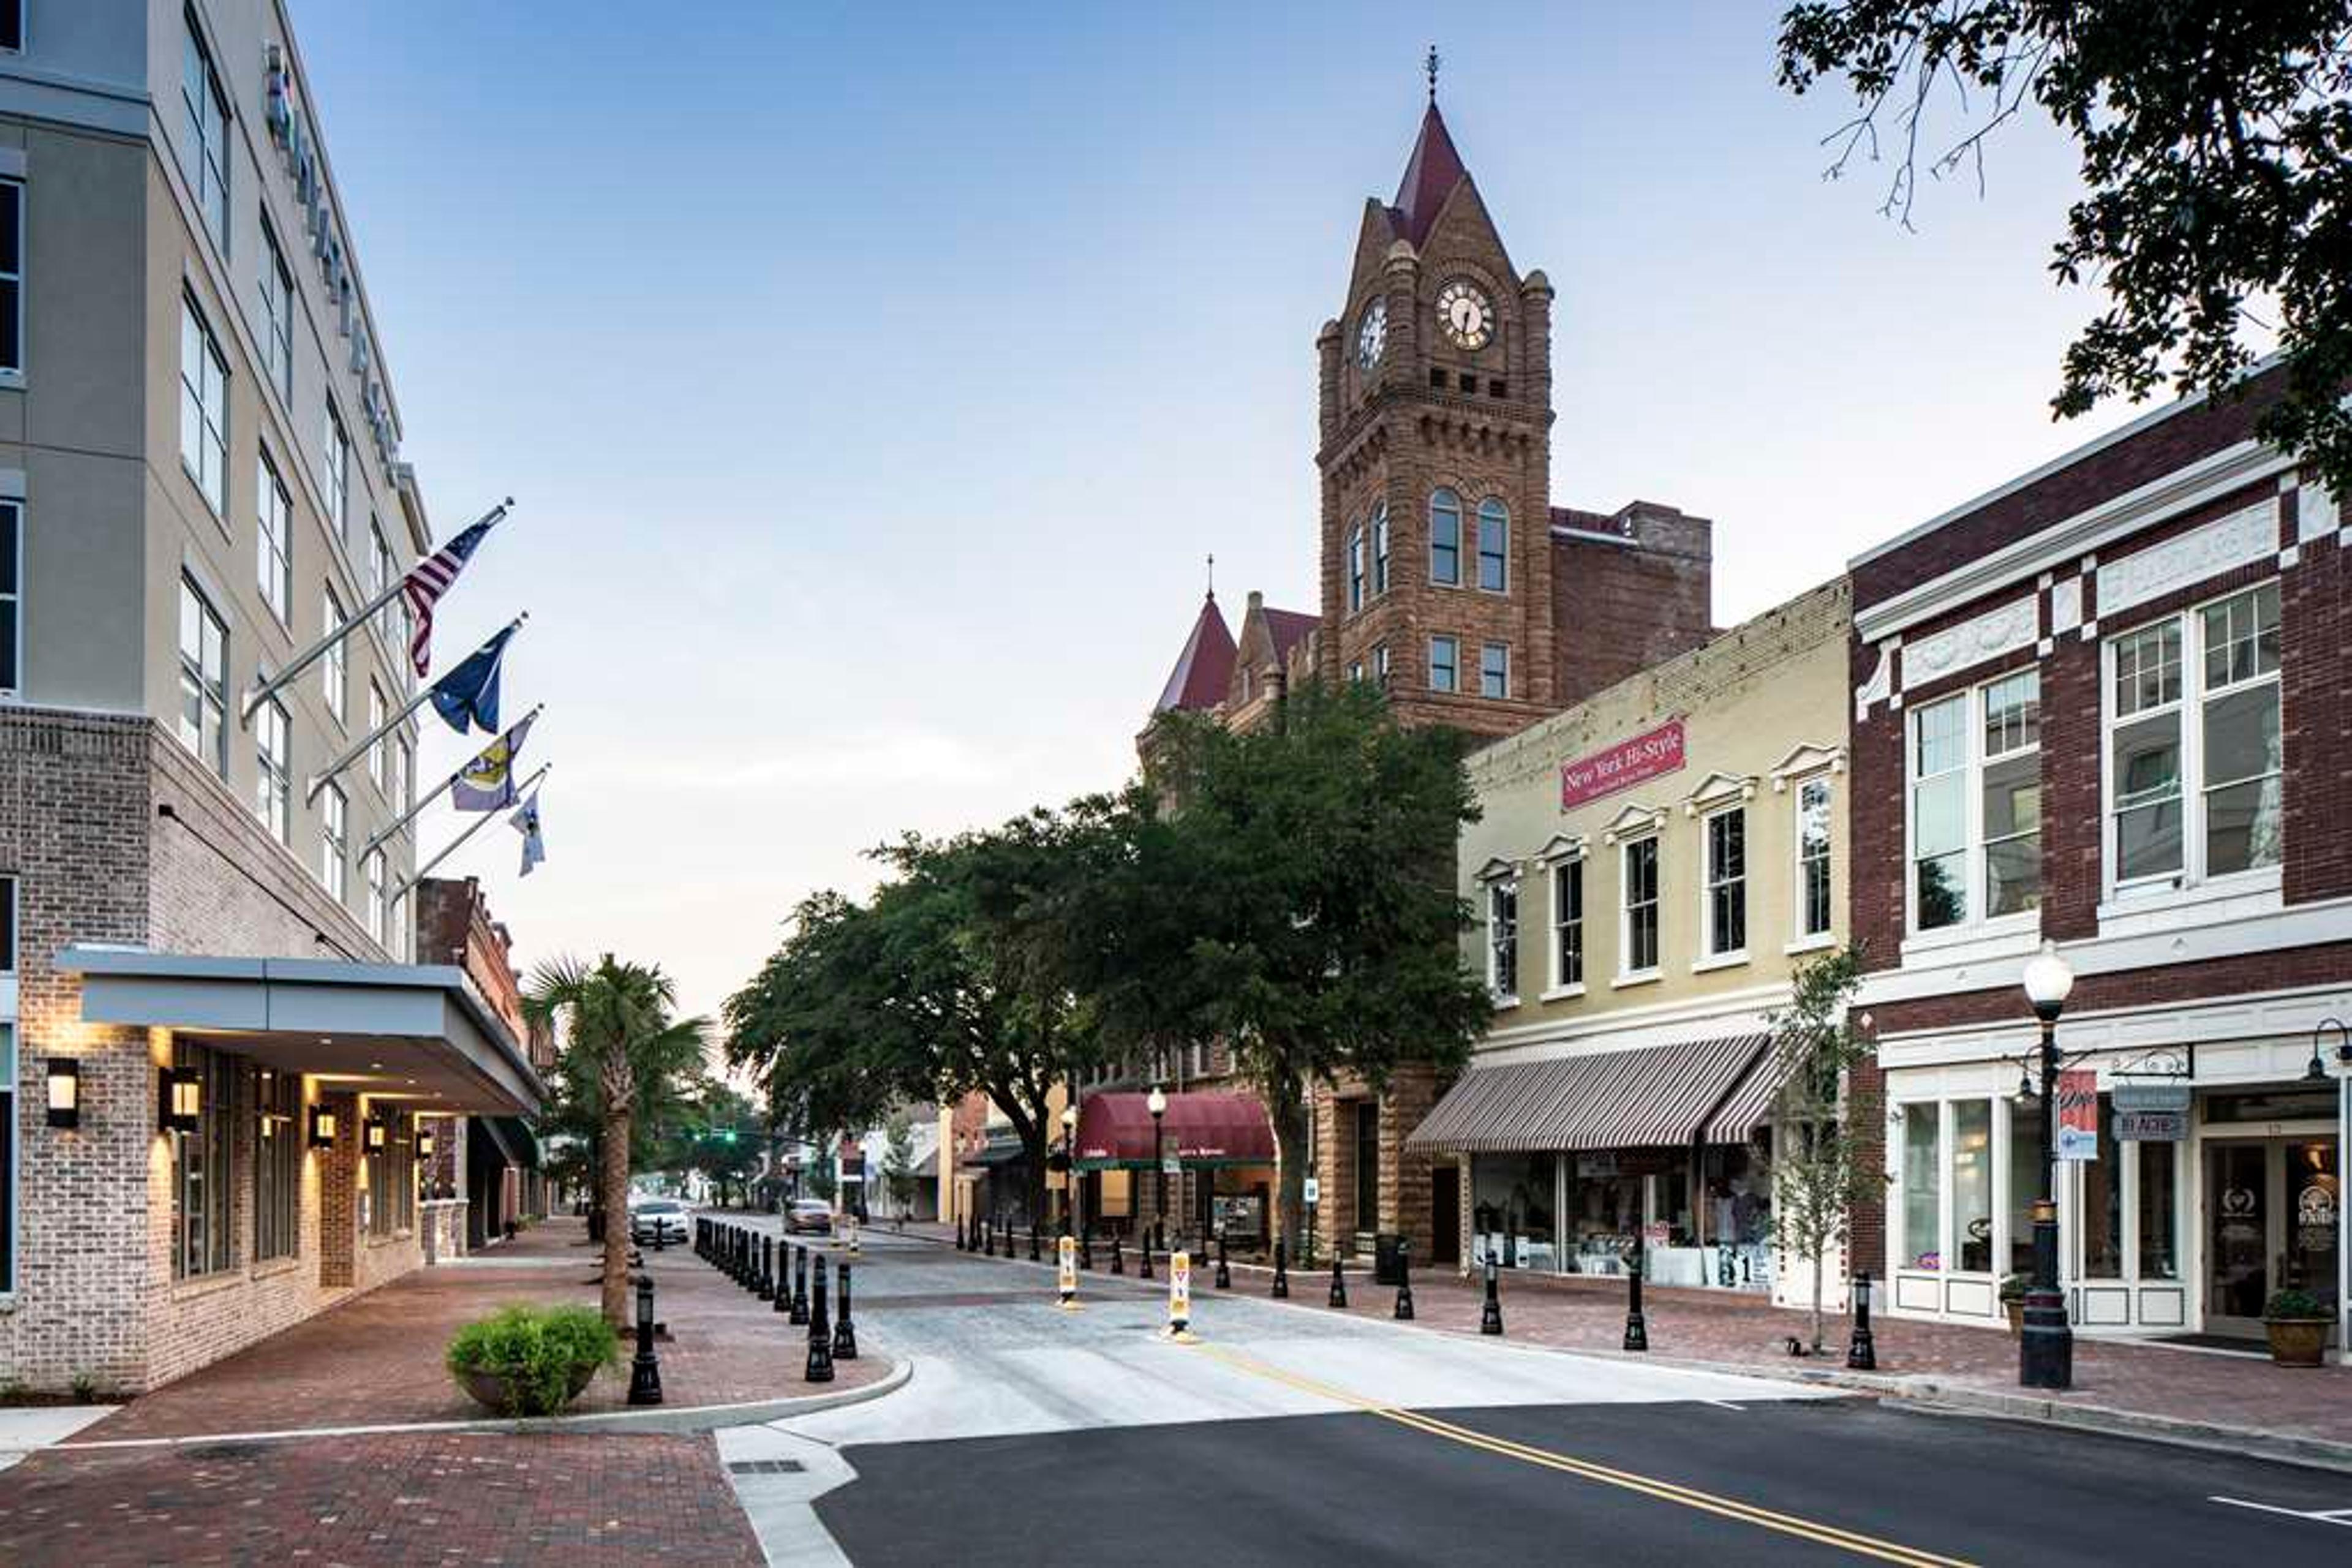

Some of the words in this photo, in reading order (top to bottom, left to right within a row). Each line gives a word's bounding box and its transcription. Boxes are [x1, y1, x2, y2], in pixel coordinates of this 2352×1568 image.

[1566, 770, 1593, 790] New
[1596, 753, 1621, 778] York
[1626, 730, 1678, 766] Hi-Style
